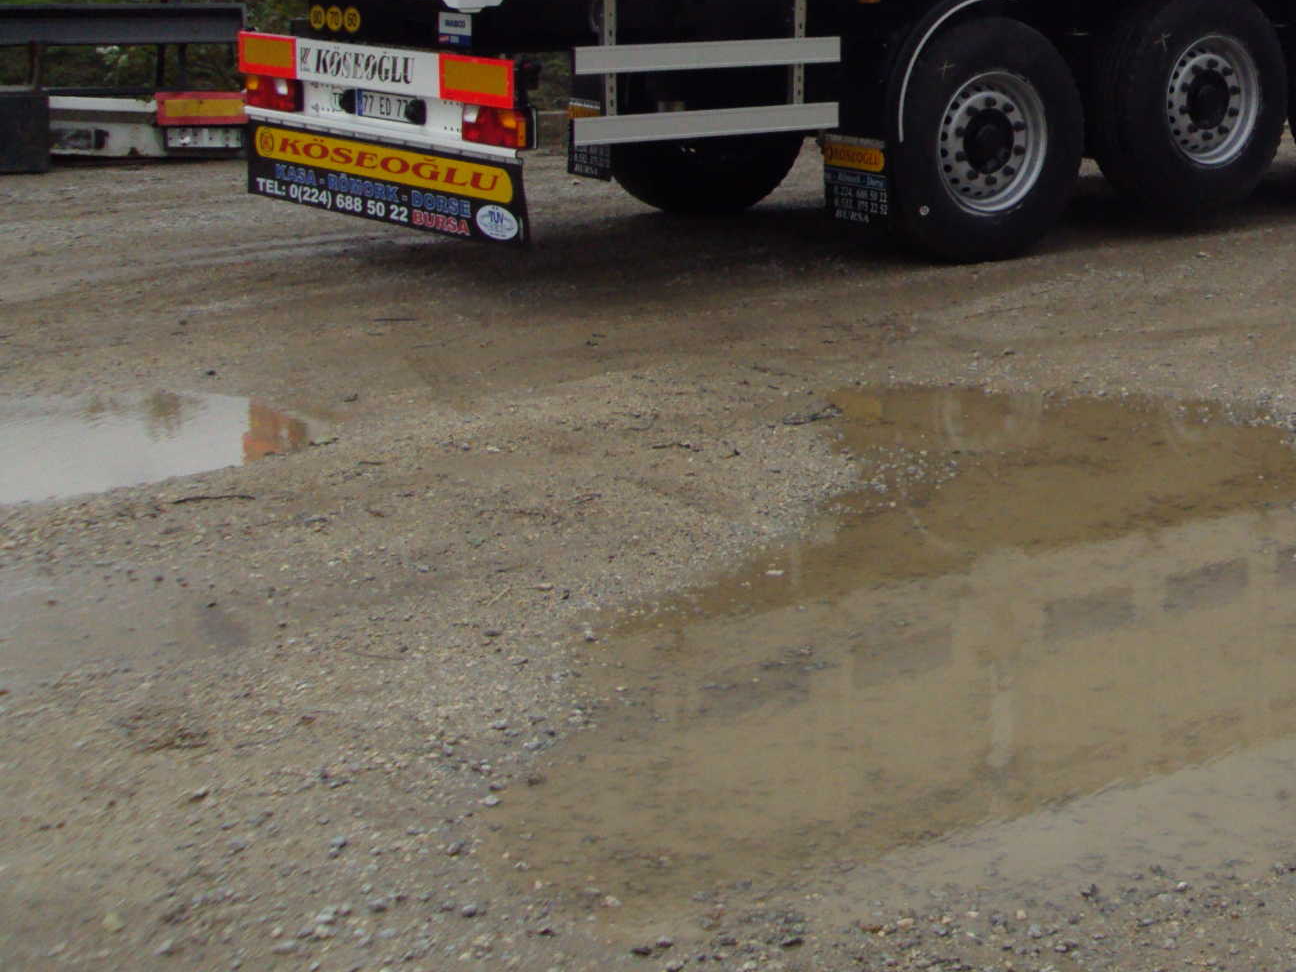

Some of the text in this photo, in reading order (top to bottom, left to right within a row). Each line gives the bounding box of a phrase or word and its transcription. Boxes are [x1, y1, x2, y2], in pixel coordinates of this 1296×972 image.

[313, 9, 323, 25] 80
[329, 11, 340, 26] 70
[346, 12, 357, 27] 60
[315, 46, 415, 85] KÖSEOĞLU
[363, 94, 375, 114] 77
[380, 97, 392, 116] ED
[278, 137, 500, 192] KÖSEOĞLU
[275, 163, 317, 186] KASA
[327, 173, 399, 203] RÖMORK
[411, 190, 472, 218] DORSE
[256, 176, 286, 196] TEL:
[289, 183, 332, 209] 0(224)
[336, 193, 363, 212] 688
[366, 199, 385, 217] 50
[389, 204, 409, 223] 22
[411, 209, 471, 236] BURSA
[488, 205, 504, 225] TÜV
[834, 208, 870, 223] BURSA
